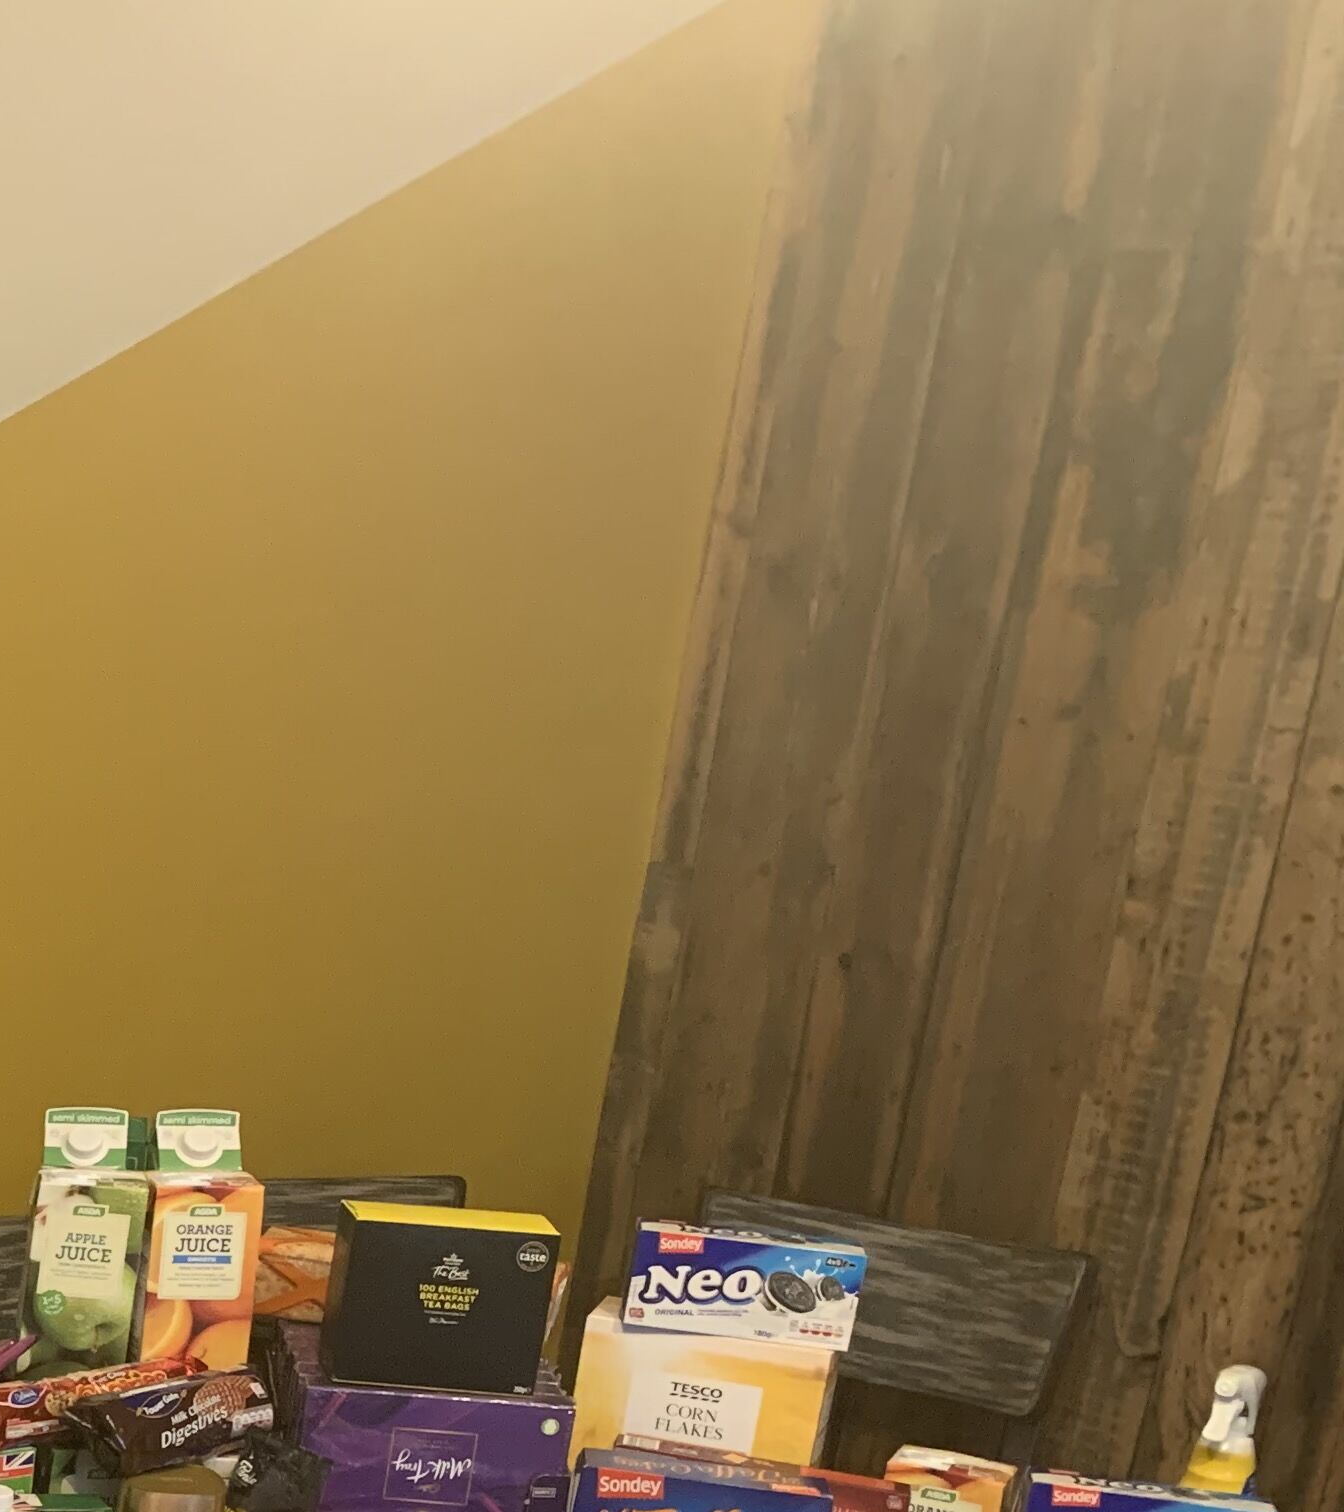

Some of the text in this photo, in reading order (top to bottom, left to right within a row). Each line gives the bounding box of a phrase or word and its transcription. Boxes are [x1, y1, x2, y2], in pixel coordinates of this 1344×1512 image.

[64, 1232, 107, 1246] APPLE
[175, 1224, 233, 1237] ORANGE
[175, 1237, 231, 1254] JUICE
[659, 1235, 703, 1253] Sondey
[55, 1246, 112, 1264] JUICE
[519, 1253, 547, 1263] taste
[419, 1283, 480, 1296] 100 ENGLISH
[645, 1264, 763, 1306] Neo
[419, 1292, 477, 1303] BREAKFAST
[423, 1300, 470, 1311] TEA BAGS
[654, 1307, 695, 1317] ORIGINAL
[670, 1381, 723, 1400] TESCO
[665, 1404, 718, 1424] CORN
[160, 1404, 228, 1450] Digestives
[654, 1416, 724, 1441] FLAKES
[598, 1475, 662, 1498] Sondey
